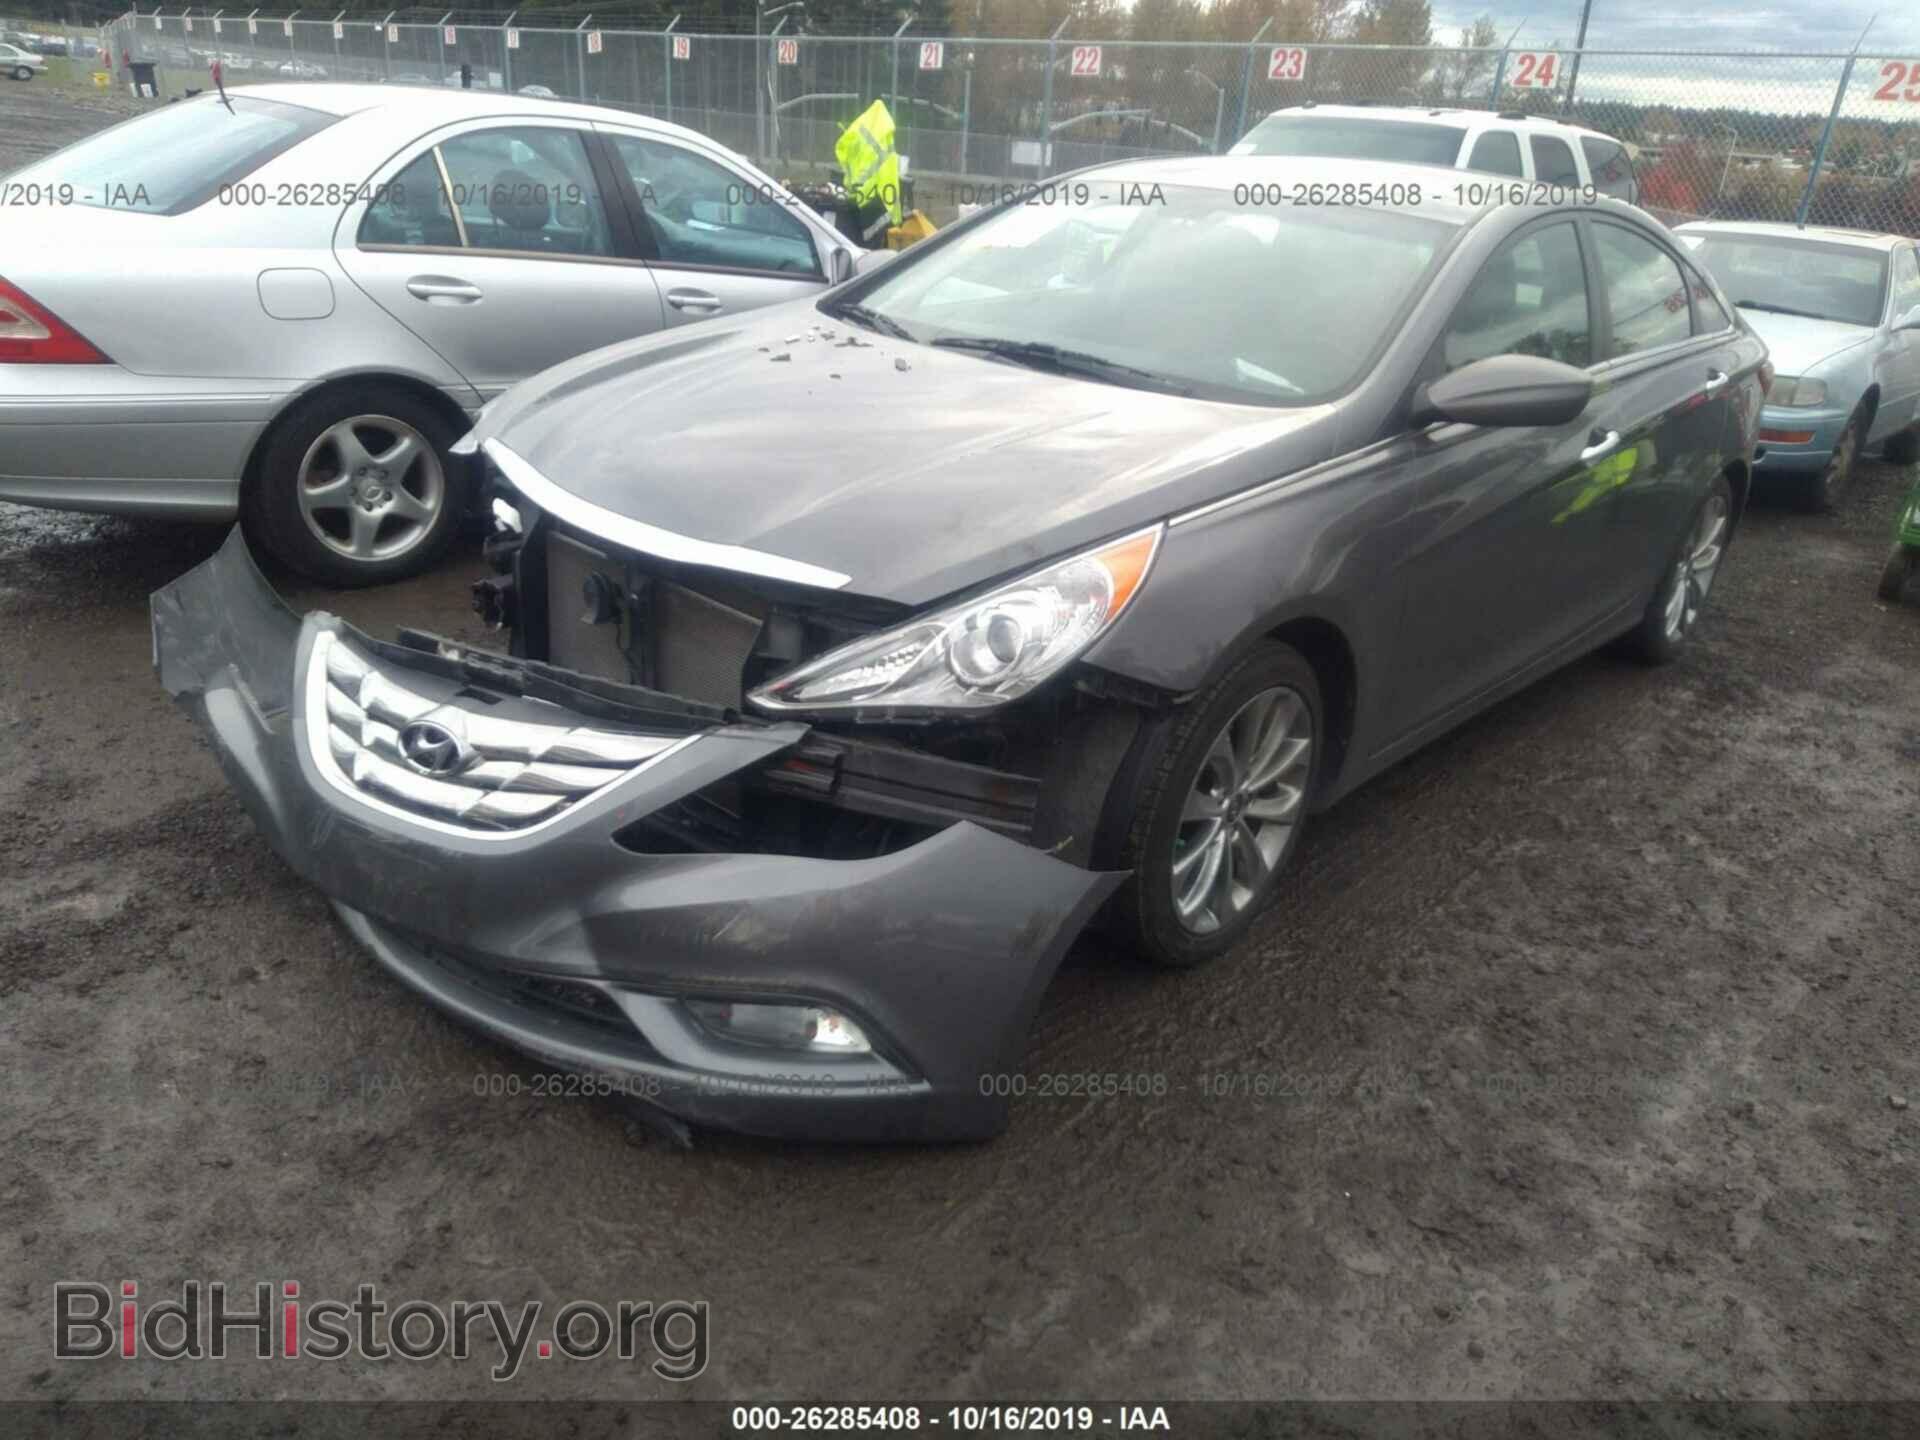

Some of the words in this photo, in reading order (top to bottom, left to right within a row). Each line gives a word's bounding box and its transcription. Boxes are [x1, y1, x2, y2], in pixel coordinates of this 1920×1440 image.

[675, 38, 688, 57] 19
[780, 40, 796, 63] 20
[923, 44, 941, 67] 21
[1074, 48, 1098, 73] 22
[1271, 50, 1302, 77] 23
[1513, 54, 1555, 86] 24
